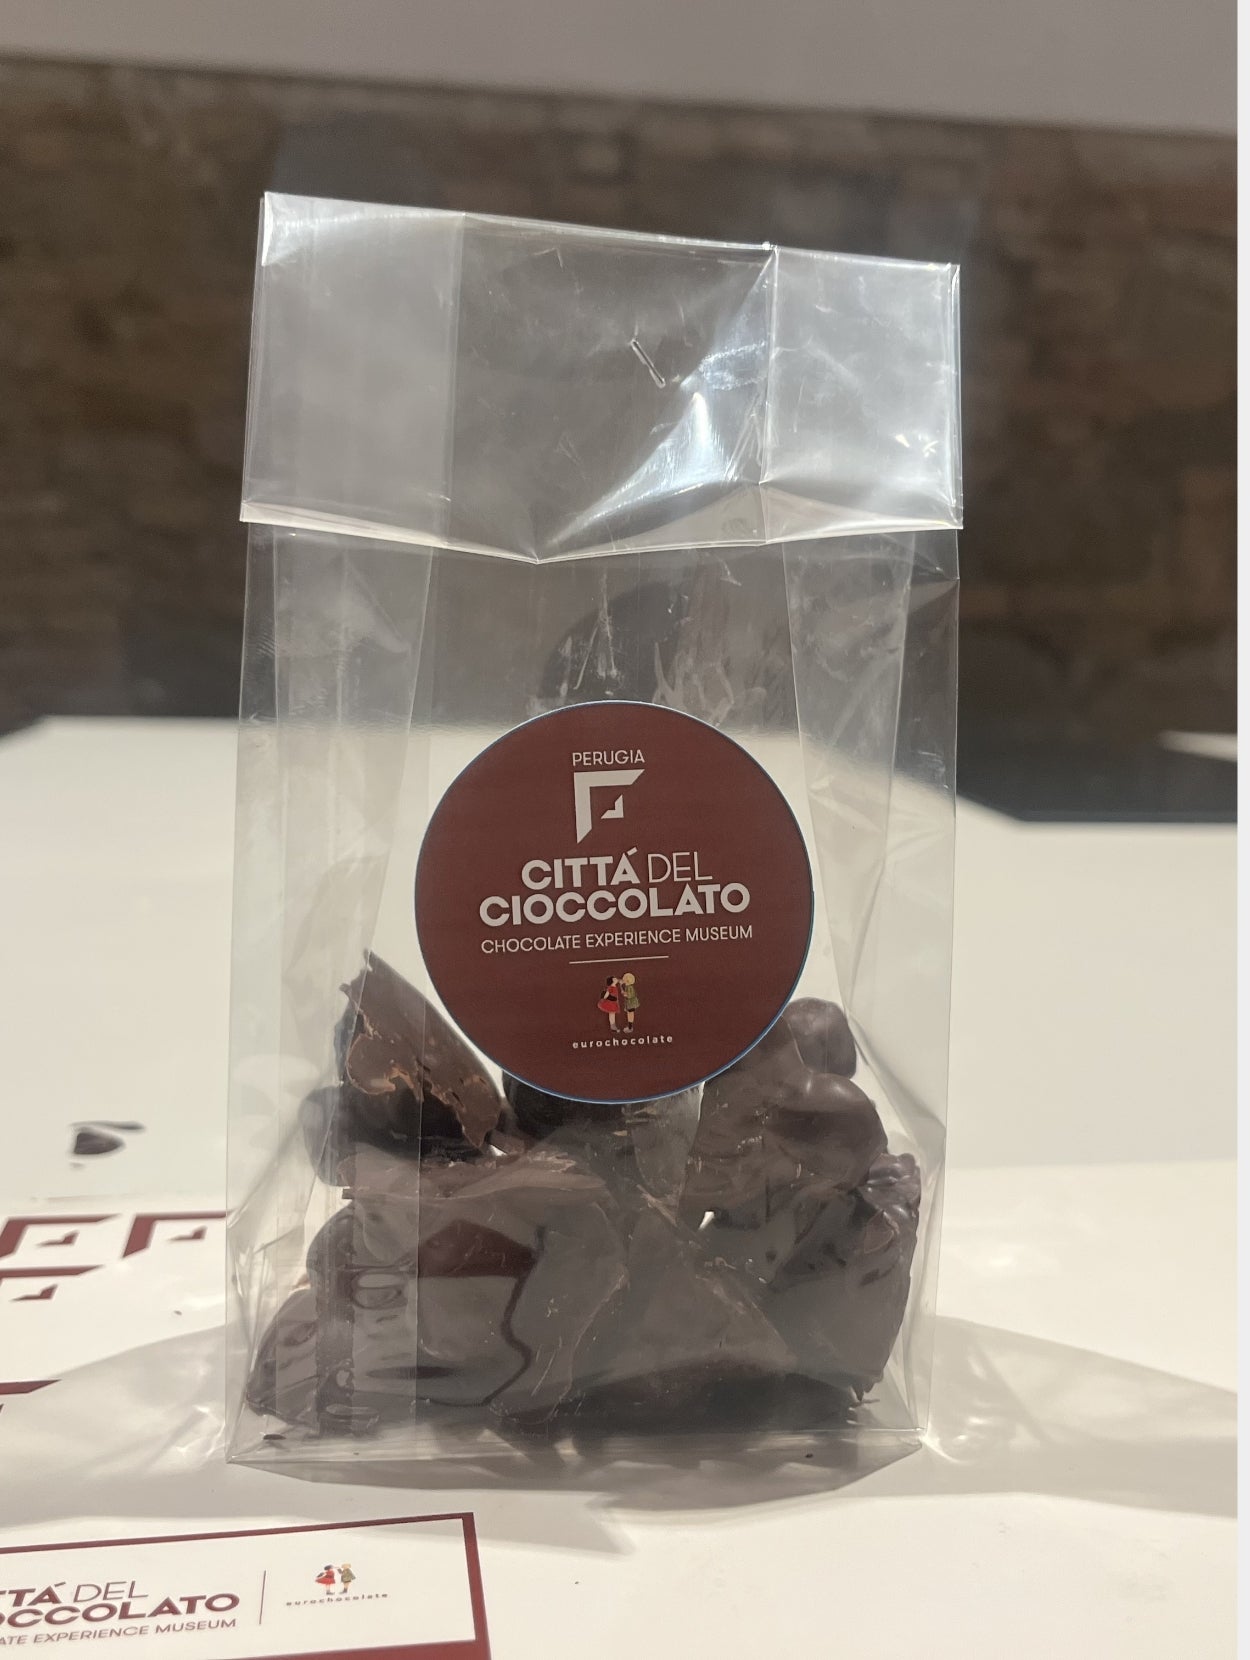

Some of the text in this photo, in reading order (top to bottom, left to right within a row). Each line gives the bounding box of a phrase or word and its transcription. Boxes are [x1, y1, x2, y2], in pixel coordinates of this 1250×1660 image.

[572, 749, 645, 766] PERUGIA
[521, 847, 713, 890] CITTÁ DEL
[479, 882, 751, 927] CIOCCOLATO
[481, 925, 753, 954] CHOCOLATE EXPERIENCE MUSEUM
[572, 1035, 674, 1048] eurochocolate
[0, 1580, 149, 1608] TÁ DEL
[286, 1592, 389, 1607] eurochocolate
[0, 1593, 240, 1628] CCOLATO
[33, 1625, 150, 1644] EXPERIENCE
[155, 1618, 237, 1634] MUSEUM
